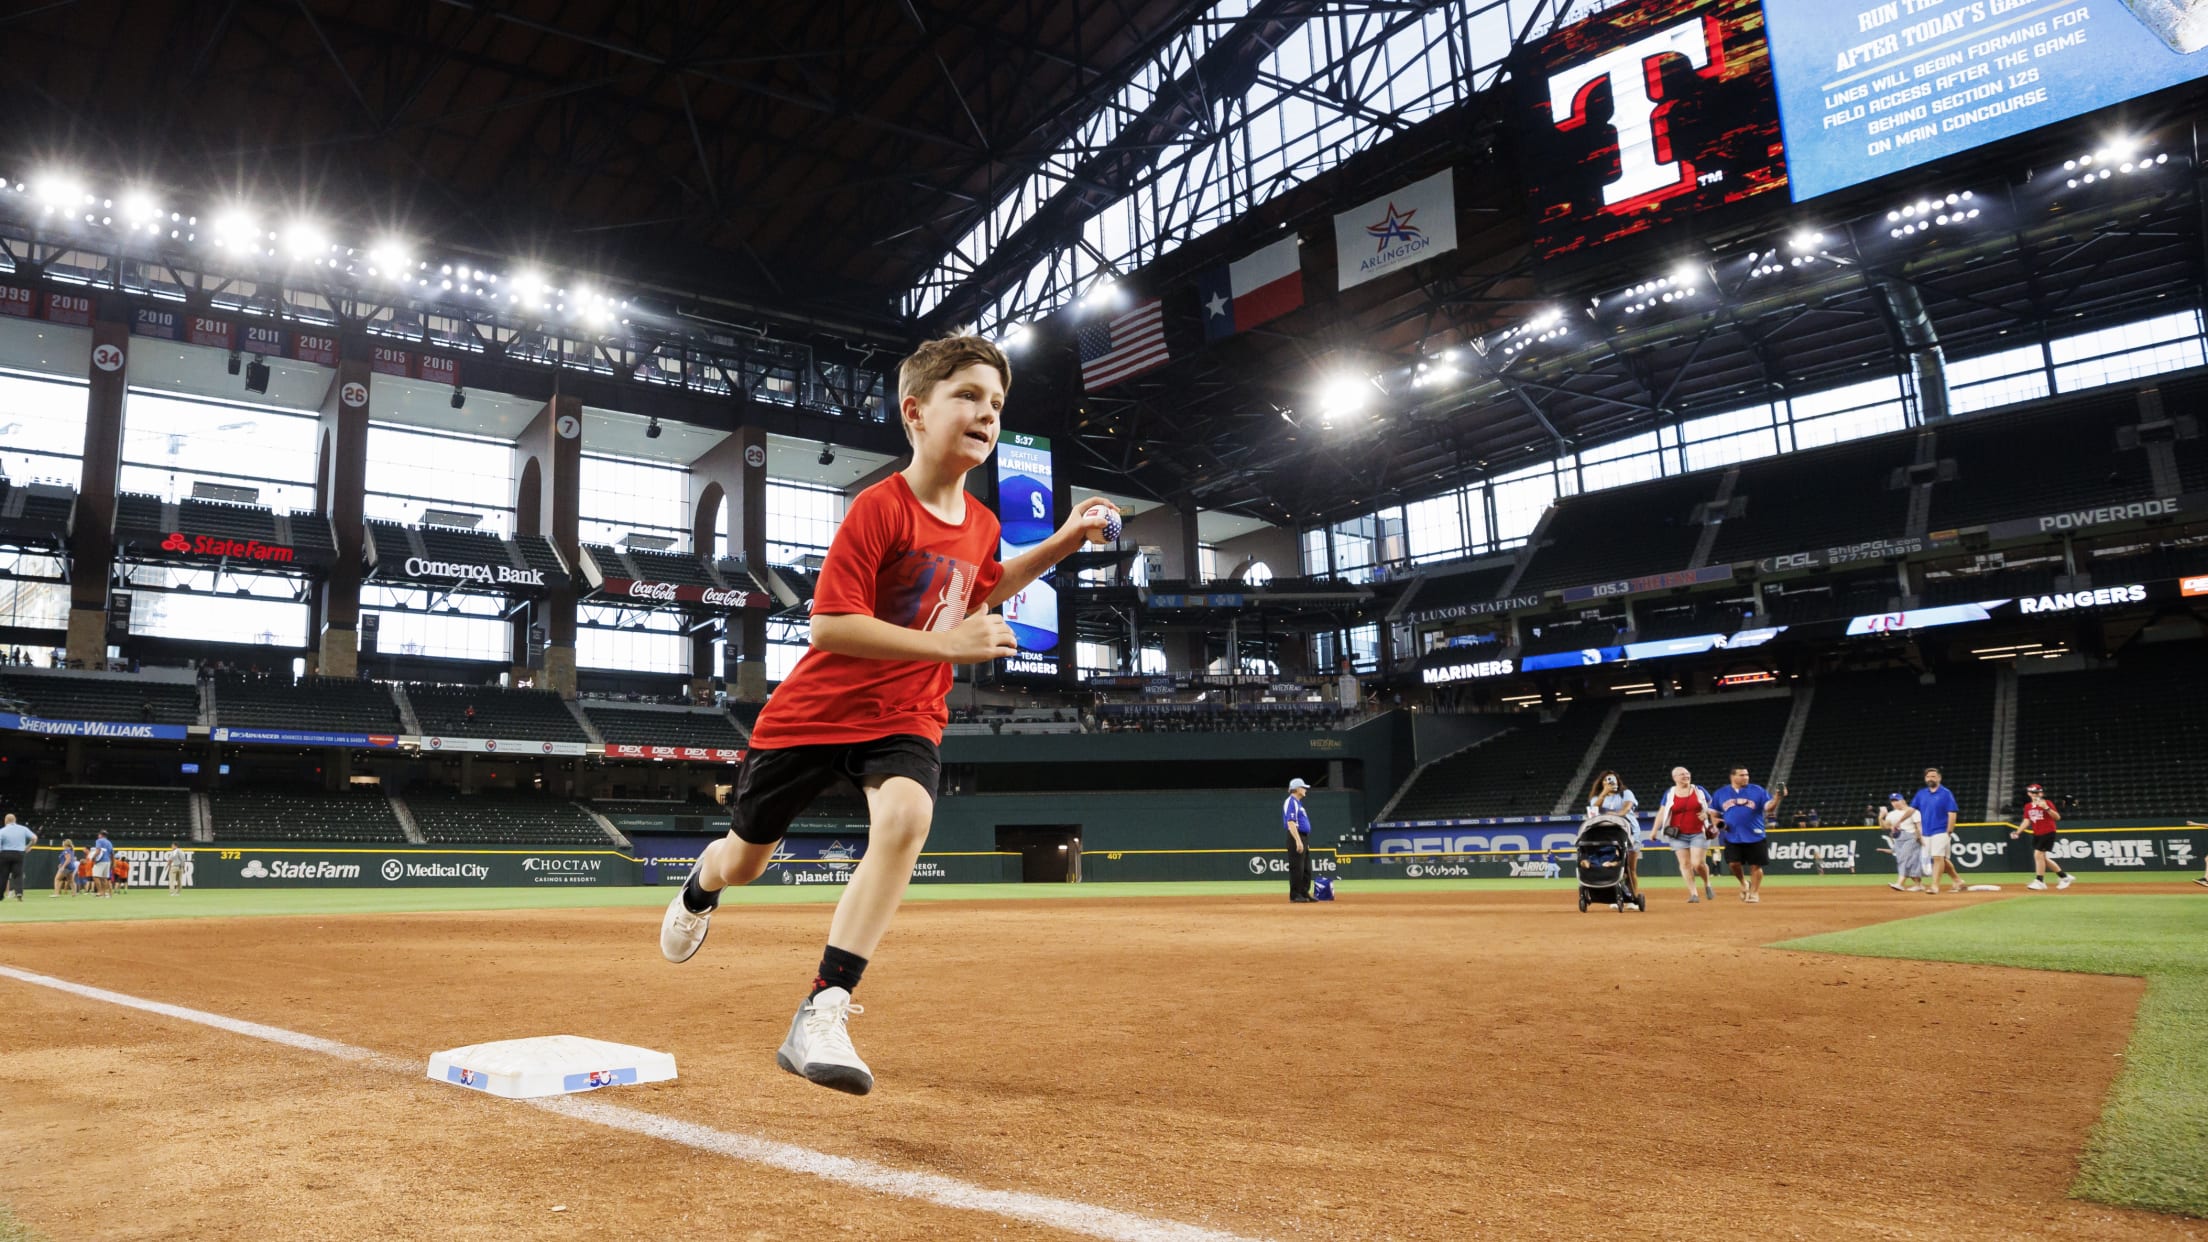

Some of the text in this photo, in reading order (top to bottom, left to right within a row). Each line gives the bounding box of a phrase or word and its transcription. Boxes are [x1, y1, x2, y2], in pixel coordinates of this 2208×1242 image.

[1857, 1, 1899, 32] RUN
[1836, 34, 1899, 72] AFTER
[1902, 5, 1986, 47] TODAY'S
[1825, 6, 2090, 110] LINES WILL BEGIN FORMING FOR
[1823, 29, 2088, 130] FIELD ACCESS AFTER THE GAME
[1548, 15, 1726, 213] T
[1867, 105, 1928, 135] BEHIND
[1931, 79, 2003, 115] SECTION
[1867, 87, 2048, 156] ON MAIN CONCOURSE
[1697, 169, 1723, 187] TM
[1360, 236, 1430, 272] ARLINGTON
[51, 294, 89, 312] 2010
[138, 308, 173, 326] 2010
[195, 318, 227, 335] 2011
[248, 327, 280, 343] 2011
[300, 335, 333, 351] 2012
[97, 349, 121, 367] 34
[375, 349, 405, 364] 2015
[423, 355, 454, 372] 2016
[343, 386, 366, 403] 26
[564, 420, 575, 434] 7
[1015, 434, 1034, 446] 5:37
[747, 450, 764, 463] 29
[1010, 450, 1039, 462] SEATTLE
[998, 457, 1052, 476] MARINERS
[2039, 498, 2179, 532] POWERADE
[1827, 537, 1922, 556] ShipPGL.com
[1828, 544, 1923, 564] 877.701.1919
[1775, 552, 1820, 569] PGL
[497, 566, 545, 586] Bank
[629, 580, 679, 600] Coca-Cola
[702, 587, 750, 607] Coca-Cola
[1592, 582, 1630, 597] 105.3
[2020, 584, 2147, 614] RANGERS
[1421, 595, 1539, 621] LUXOR STAFFING
[1712, 636, 1728, 648] VS
[1021, 652, 1043, 661] TEXAS
[1006, 660, 1058, 675] RANGERS
[1423, 660, 1513, 683] MARINERS
[618, 744, 642, 753] DEX
[652, 746, 676, 755] DEX
[684, 747, 707, 756] DEX
[716, 749, 739, 757] DEX
[150, 850, 195, 862] LIGT
[220, 851, 241, 860] 372
[1107, 852, 1122, 860] 407
[1379, 834, 1530, 864] GEICO
[2092, 839, 2153, 858] BITE
[531, 858, 602, 871] CHOCTAW
[913, 863, 938, 871] NERGY
[1311, 858, 1337, 872] Life
[1425, 864, 1469, 876] Kubota
[1793, 860, 1814, 869] Car
[2104, 857, 2146, 867] PIZZA
[127, 861, 195, 887] ELTZR
[406, 862, 490, 880] Medical City
[795, 871, 832, 884] planet
